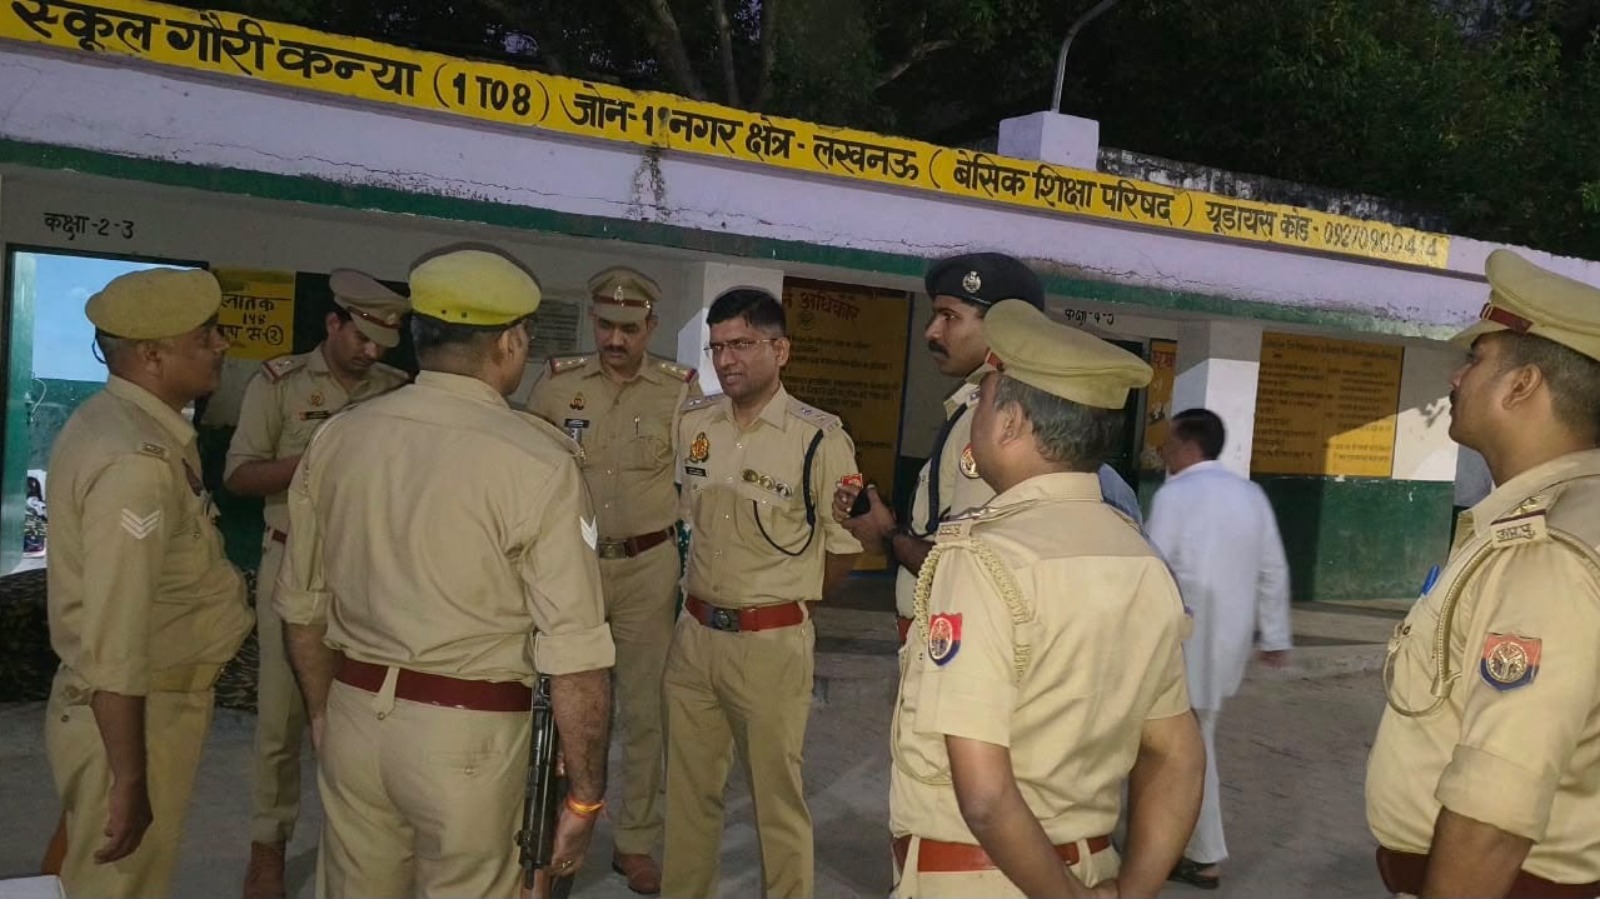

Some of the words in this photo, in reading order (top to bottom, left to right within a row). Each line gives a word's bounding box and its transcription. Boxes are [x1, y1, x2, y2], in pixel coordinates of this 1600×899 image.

[11, 0, 160, 52] स्कूल
[165, 12, 274, 75] गौरी
[276, 40, 422, 97] कन्या
[667, 109, 743, 154] नगर
[813, 134, 919, 181] लखनऊ
[1031, 164, 1097, 210] शिक्षा
[1204, 201, 1278, 236] यूडायस
